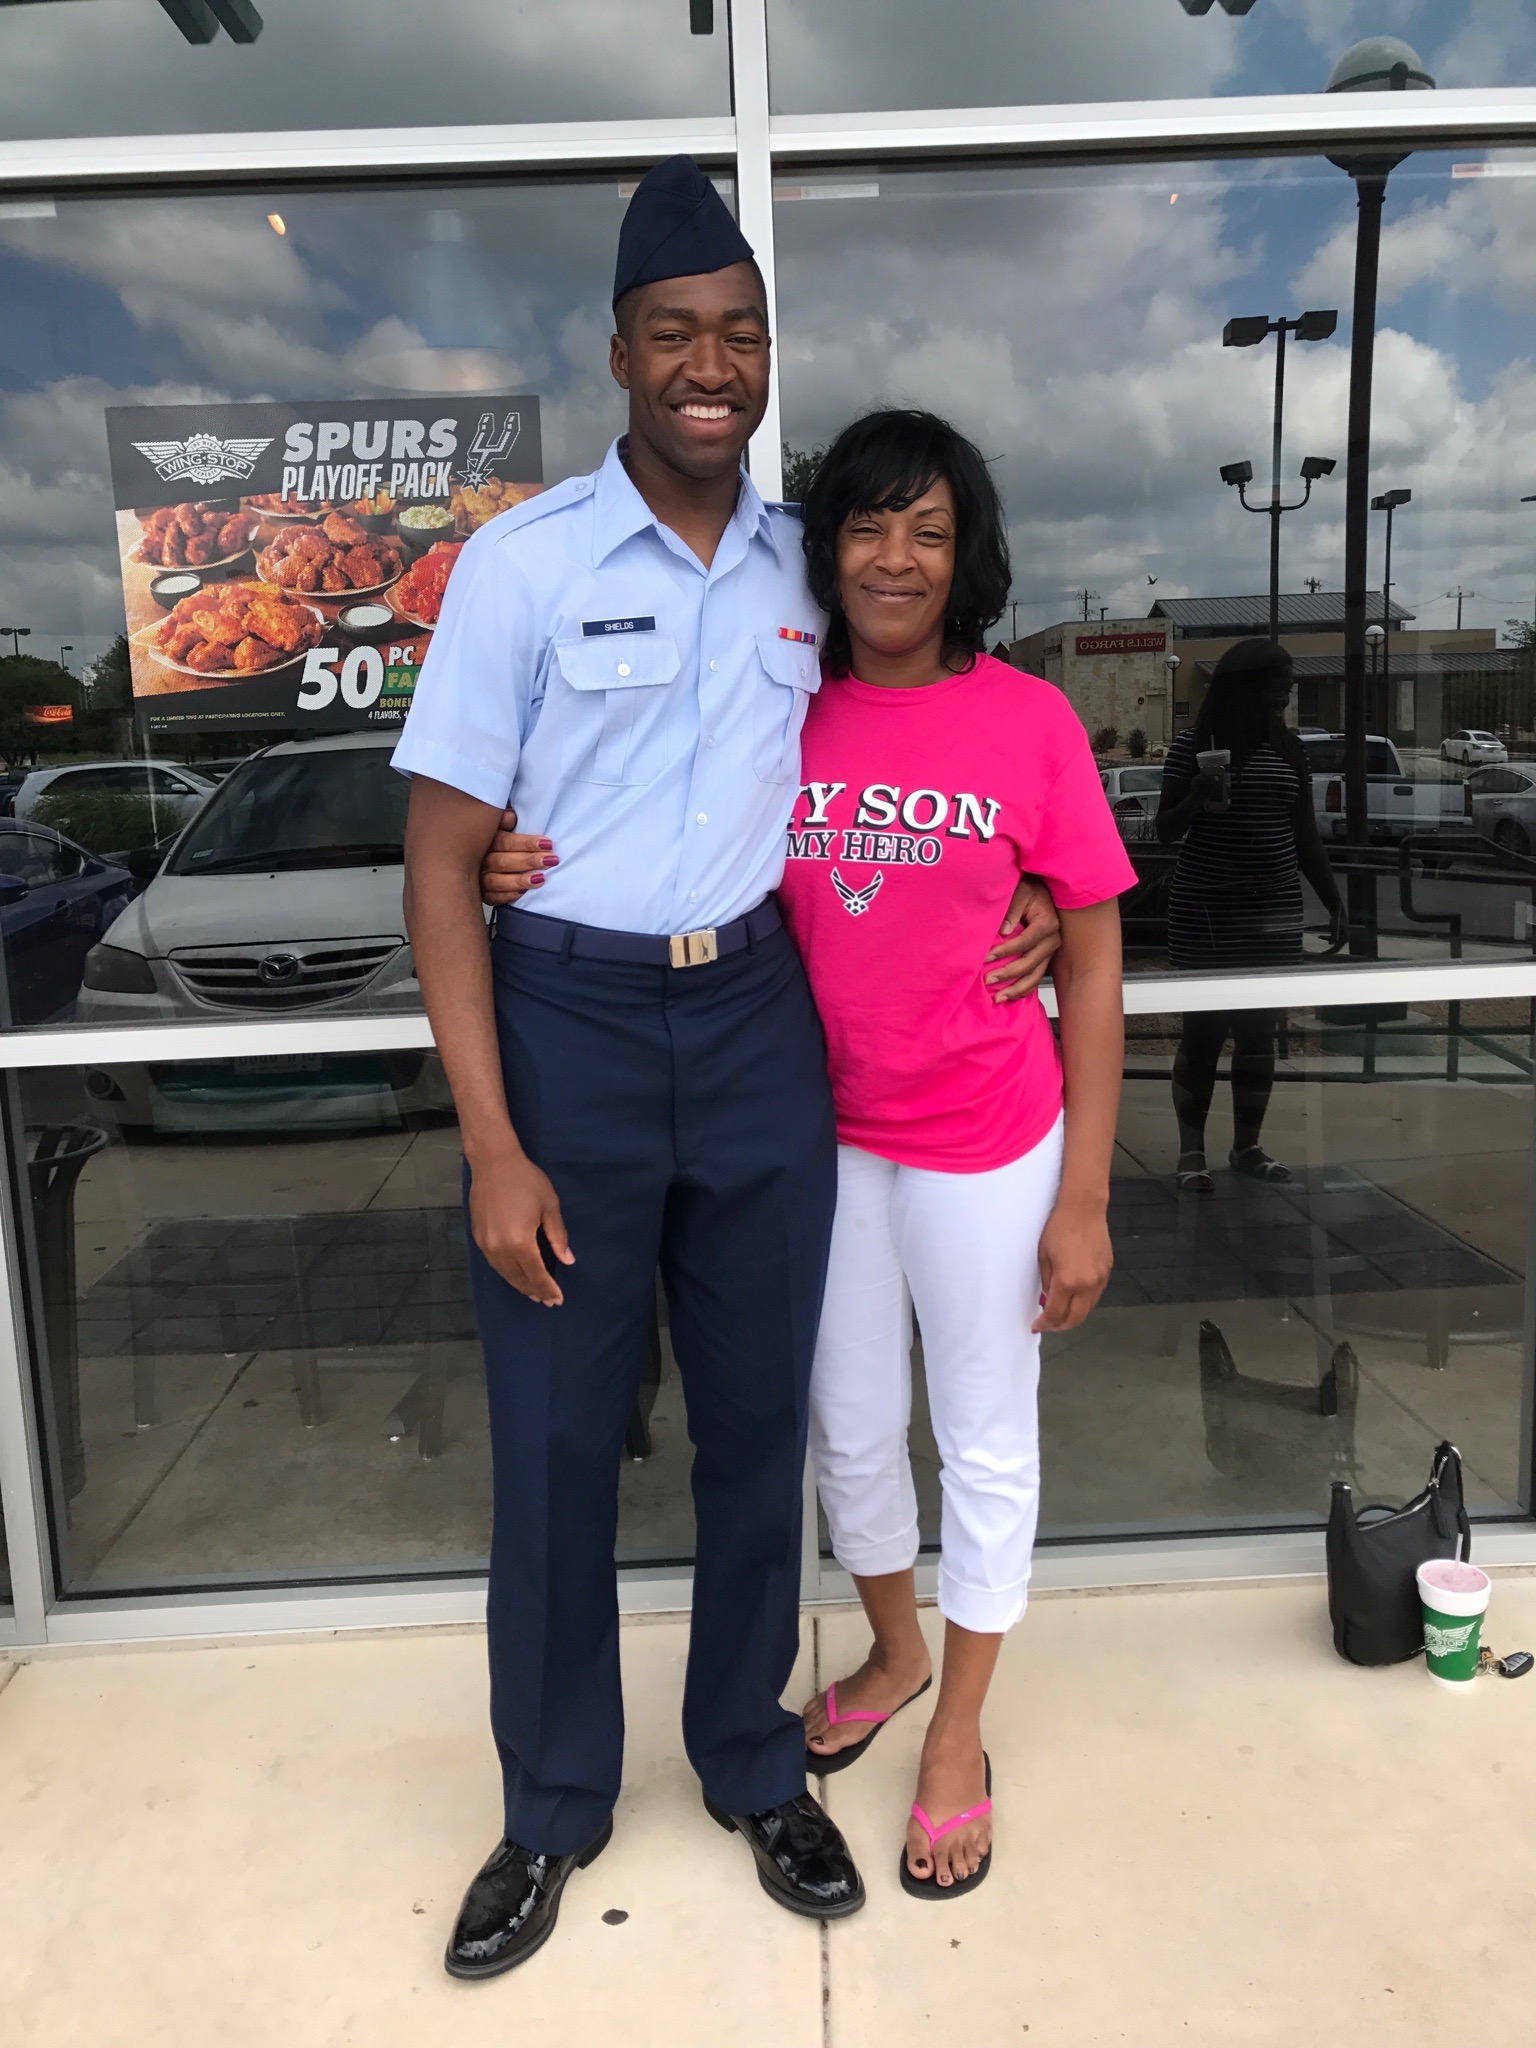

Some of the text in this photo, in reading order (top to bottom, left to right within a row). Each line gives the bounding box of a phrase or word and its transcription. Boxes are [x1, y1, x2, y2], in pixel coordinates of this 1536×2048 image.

[282, 418, 458, 463] SPURS
[281, 461, 453, 501] PLAYOFF PACK
[604, 621, 634, 632] SHIELDS
[388, 646, 416, 666] PC
[297, 645, 384, 711] 50
[368, 710, 373, 720] 4
[373, 710, 402, 720] FLAVORS,
[787, 782, 1001, 844] Y SON
[785, 829, 943, 867] MY HERO
